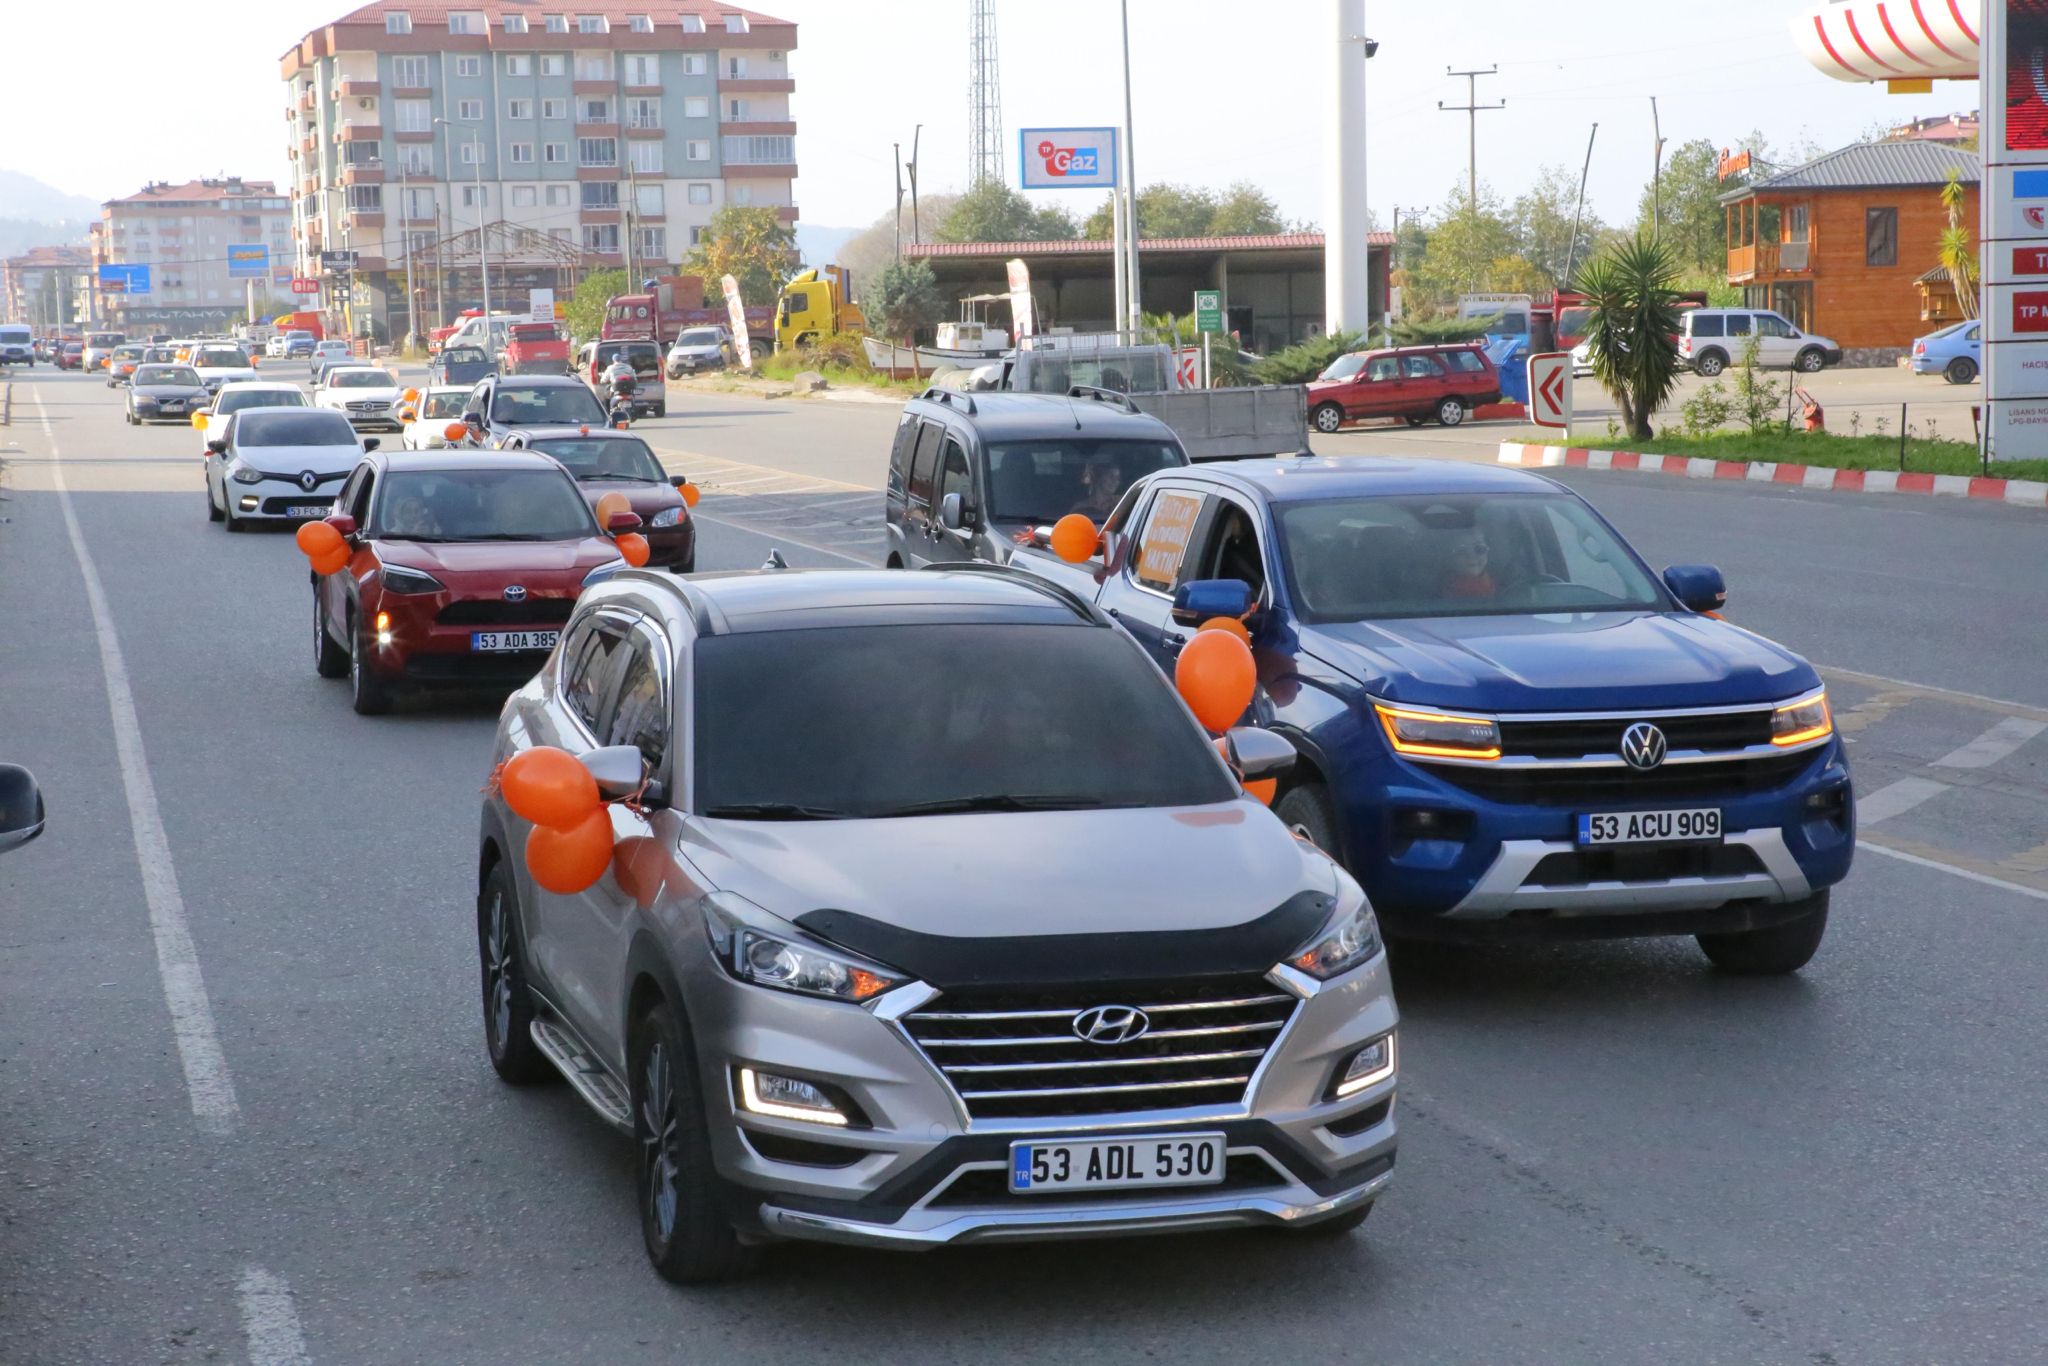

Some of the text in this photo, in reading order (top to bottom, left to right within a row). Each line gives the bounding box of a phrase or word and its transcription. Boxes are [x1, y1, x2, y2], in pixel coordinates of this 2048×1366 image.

[1055, 151, 1096, 171] Gaz
[2020, 306, 2038, 318] TP
[481, 632, 556, 648] 53 ADA 385
[1591, 815, 1619, 840] 53
[1627, 813, 1672, 839] ACU
[1678, 811, 1719, 837] 909
[1016, 1142, 1214, 1182] TR 53 ADL 530
